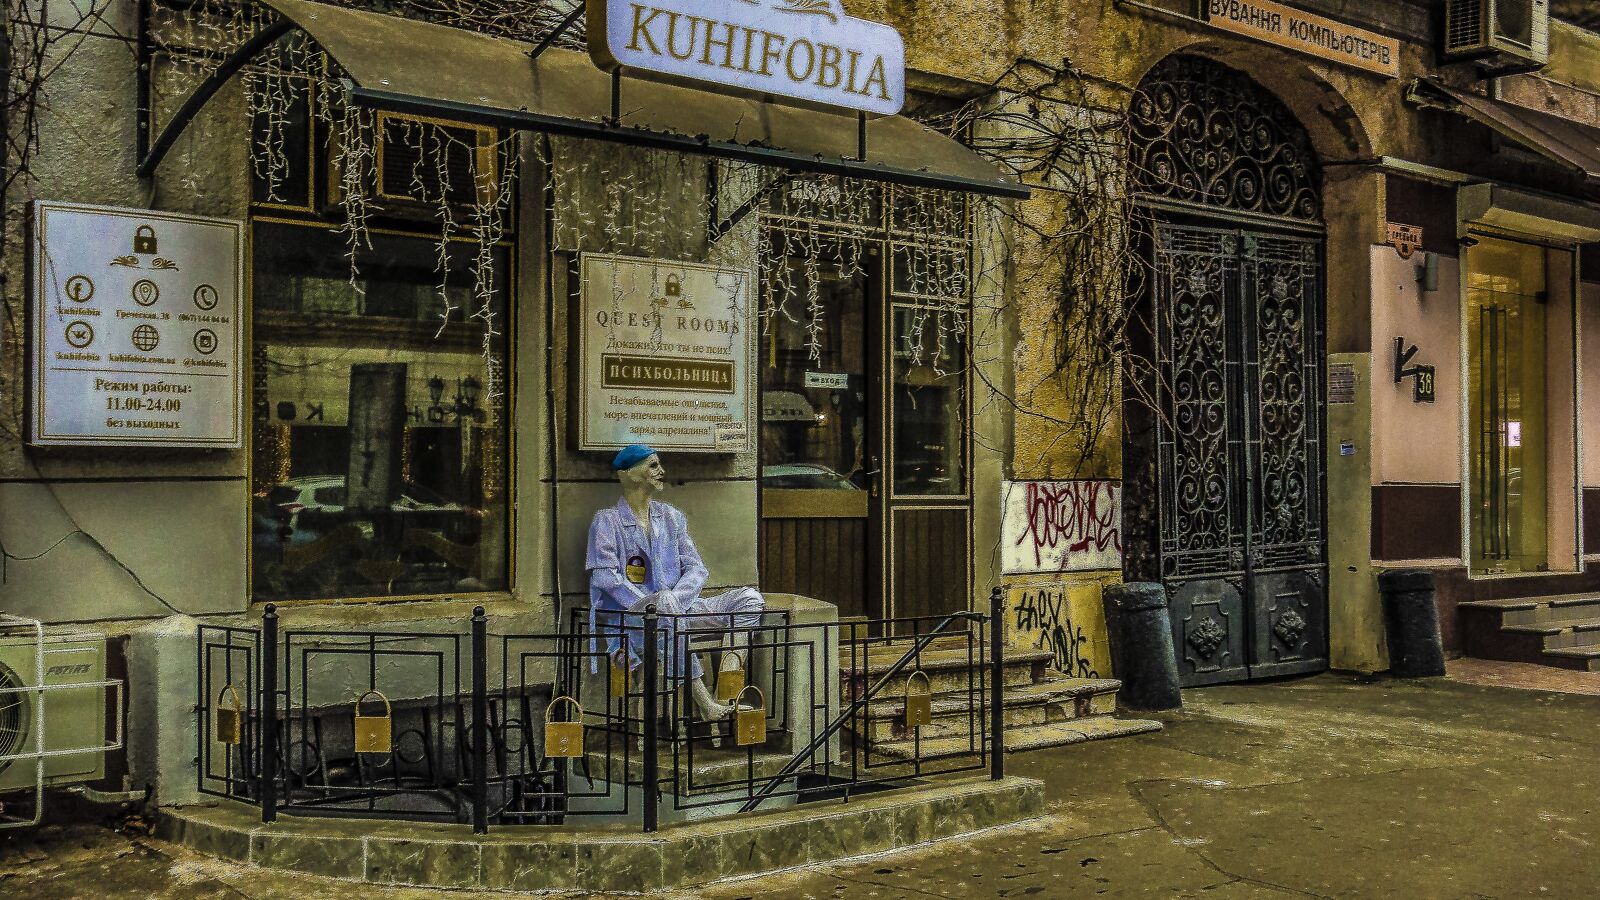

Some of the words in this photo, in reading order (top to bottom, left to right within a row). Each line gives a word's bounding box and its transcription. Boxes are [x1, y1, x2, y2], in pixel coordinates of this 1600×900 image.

[1288, 17, 1392, 65] КОМПЬЮТЕРІВ
[625, 3, 892, 101] KUHIFOBIA
[160, 312, 170, 320] 38
[596, 310, 663, 329] QUEST
[677, 316, 740, 335] ROOMS
[676, 344, 690, 353] ты
[692, 344, 704, 353] не
[610, 365, 729, 384] ПСИХБОЛЬНИЦА
[95, 378, 139, 393] Режим
[142, 380, 193, 396] работы:
[1418, 372, 1432, 394] 38
[106, 397, 181, 412] 11.00-24.00
[609, 395, 679, 408] Незабываемые
[106, 417, 124, 429] без
[126, 420, 181, 429] выходных
[604, 411, 628, 422] море
[630, 411, 688, 421] впечатлений
[697, 411, 733, 424] мощный
[629, 426, 656, 438] заряд
